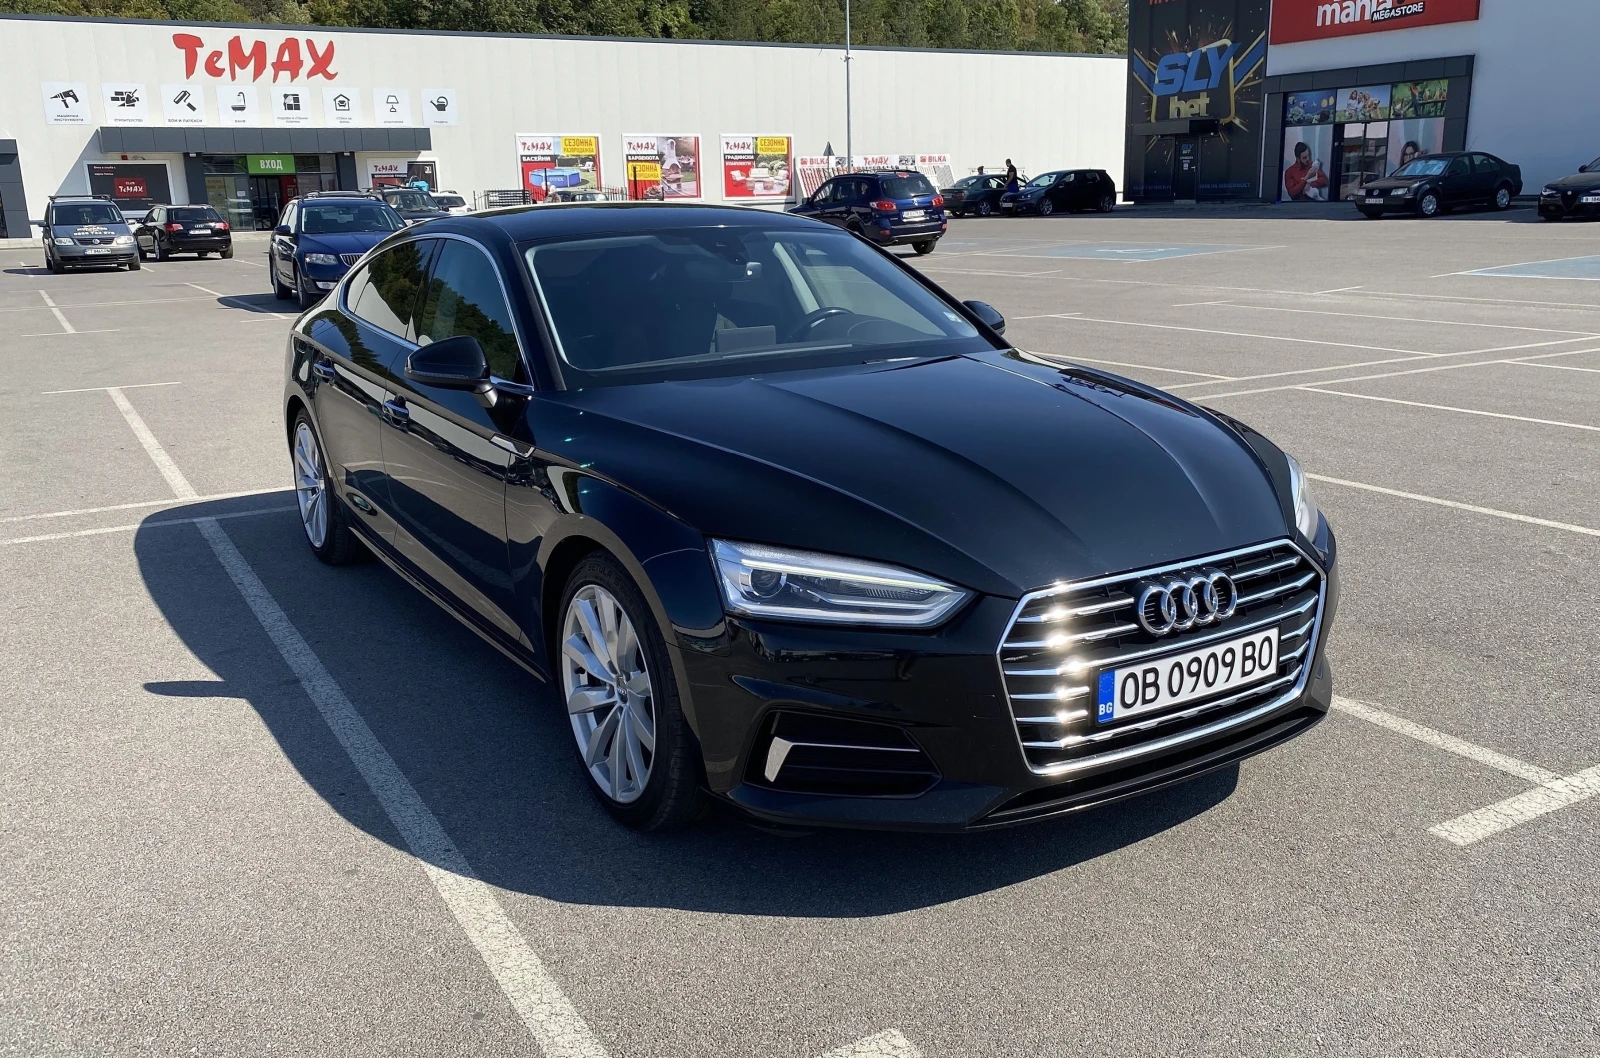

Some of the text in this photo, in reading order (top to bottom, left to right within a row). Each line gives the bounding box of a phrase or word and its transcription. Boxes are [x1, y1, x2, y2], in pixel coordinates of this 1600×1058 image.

[1372, 2, 1424, 21] MEGASTORE
[1152, 42, 1242, 96] SLY
[564, 138, 593, 147] СЕЗОННА
[760, 138, 785, 147] СЕЗОННА
[260, 159, 283, 170] ВХОД
[809, 157, 829, 165] BILKA
[1121, 636, 1273, 709] OB 0909 BO
[1098, 701, 1113, 716] BG
